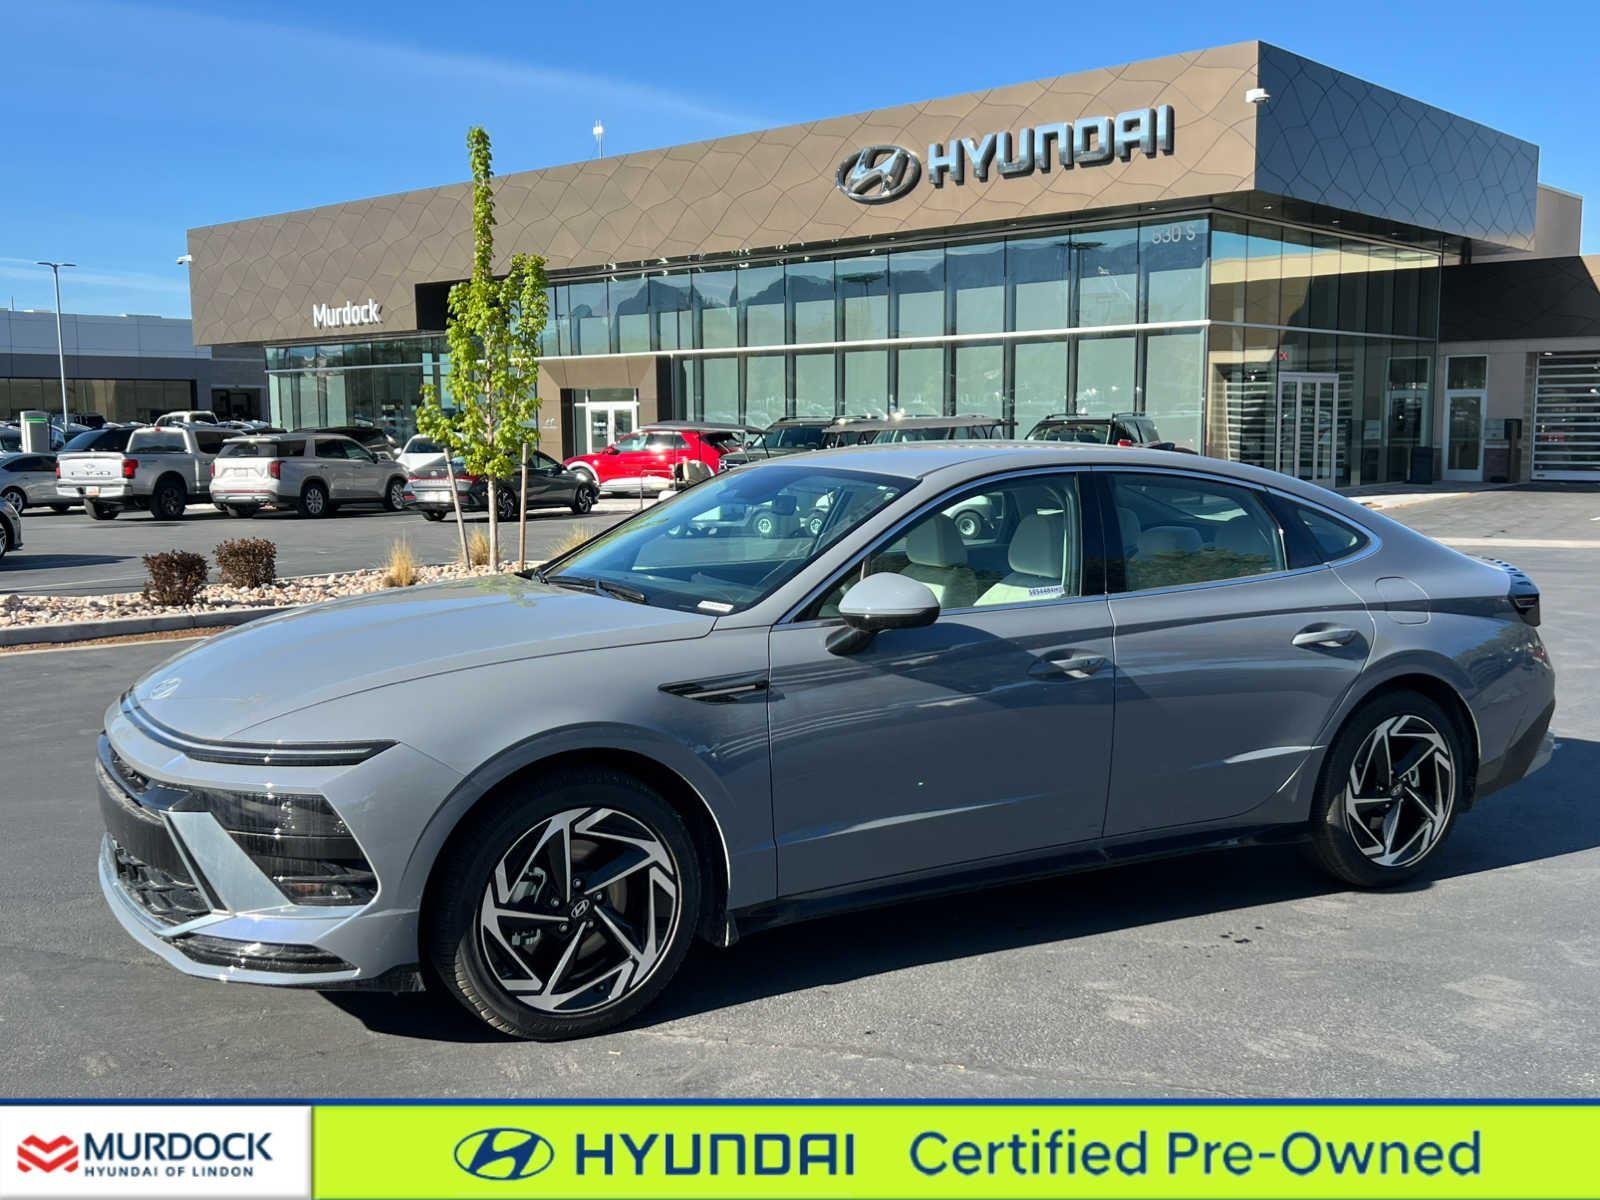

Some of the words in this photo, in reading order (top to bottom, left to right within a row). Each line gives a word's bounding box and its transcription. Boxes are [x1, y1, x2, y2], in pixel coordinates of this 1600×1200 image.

[927, 104, 1173, 188] HYUNDAI
[1186, 222, 1196, 241] S
[313, 298, 379, 328] Murdock
